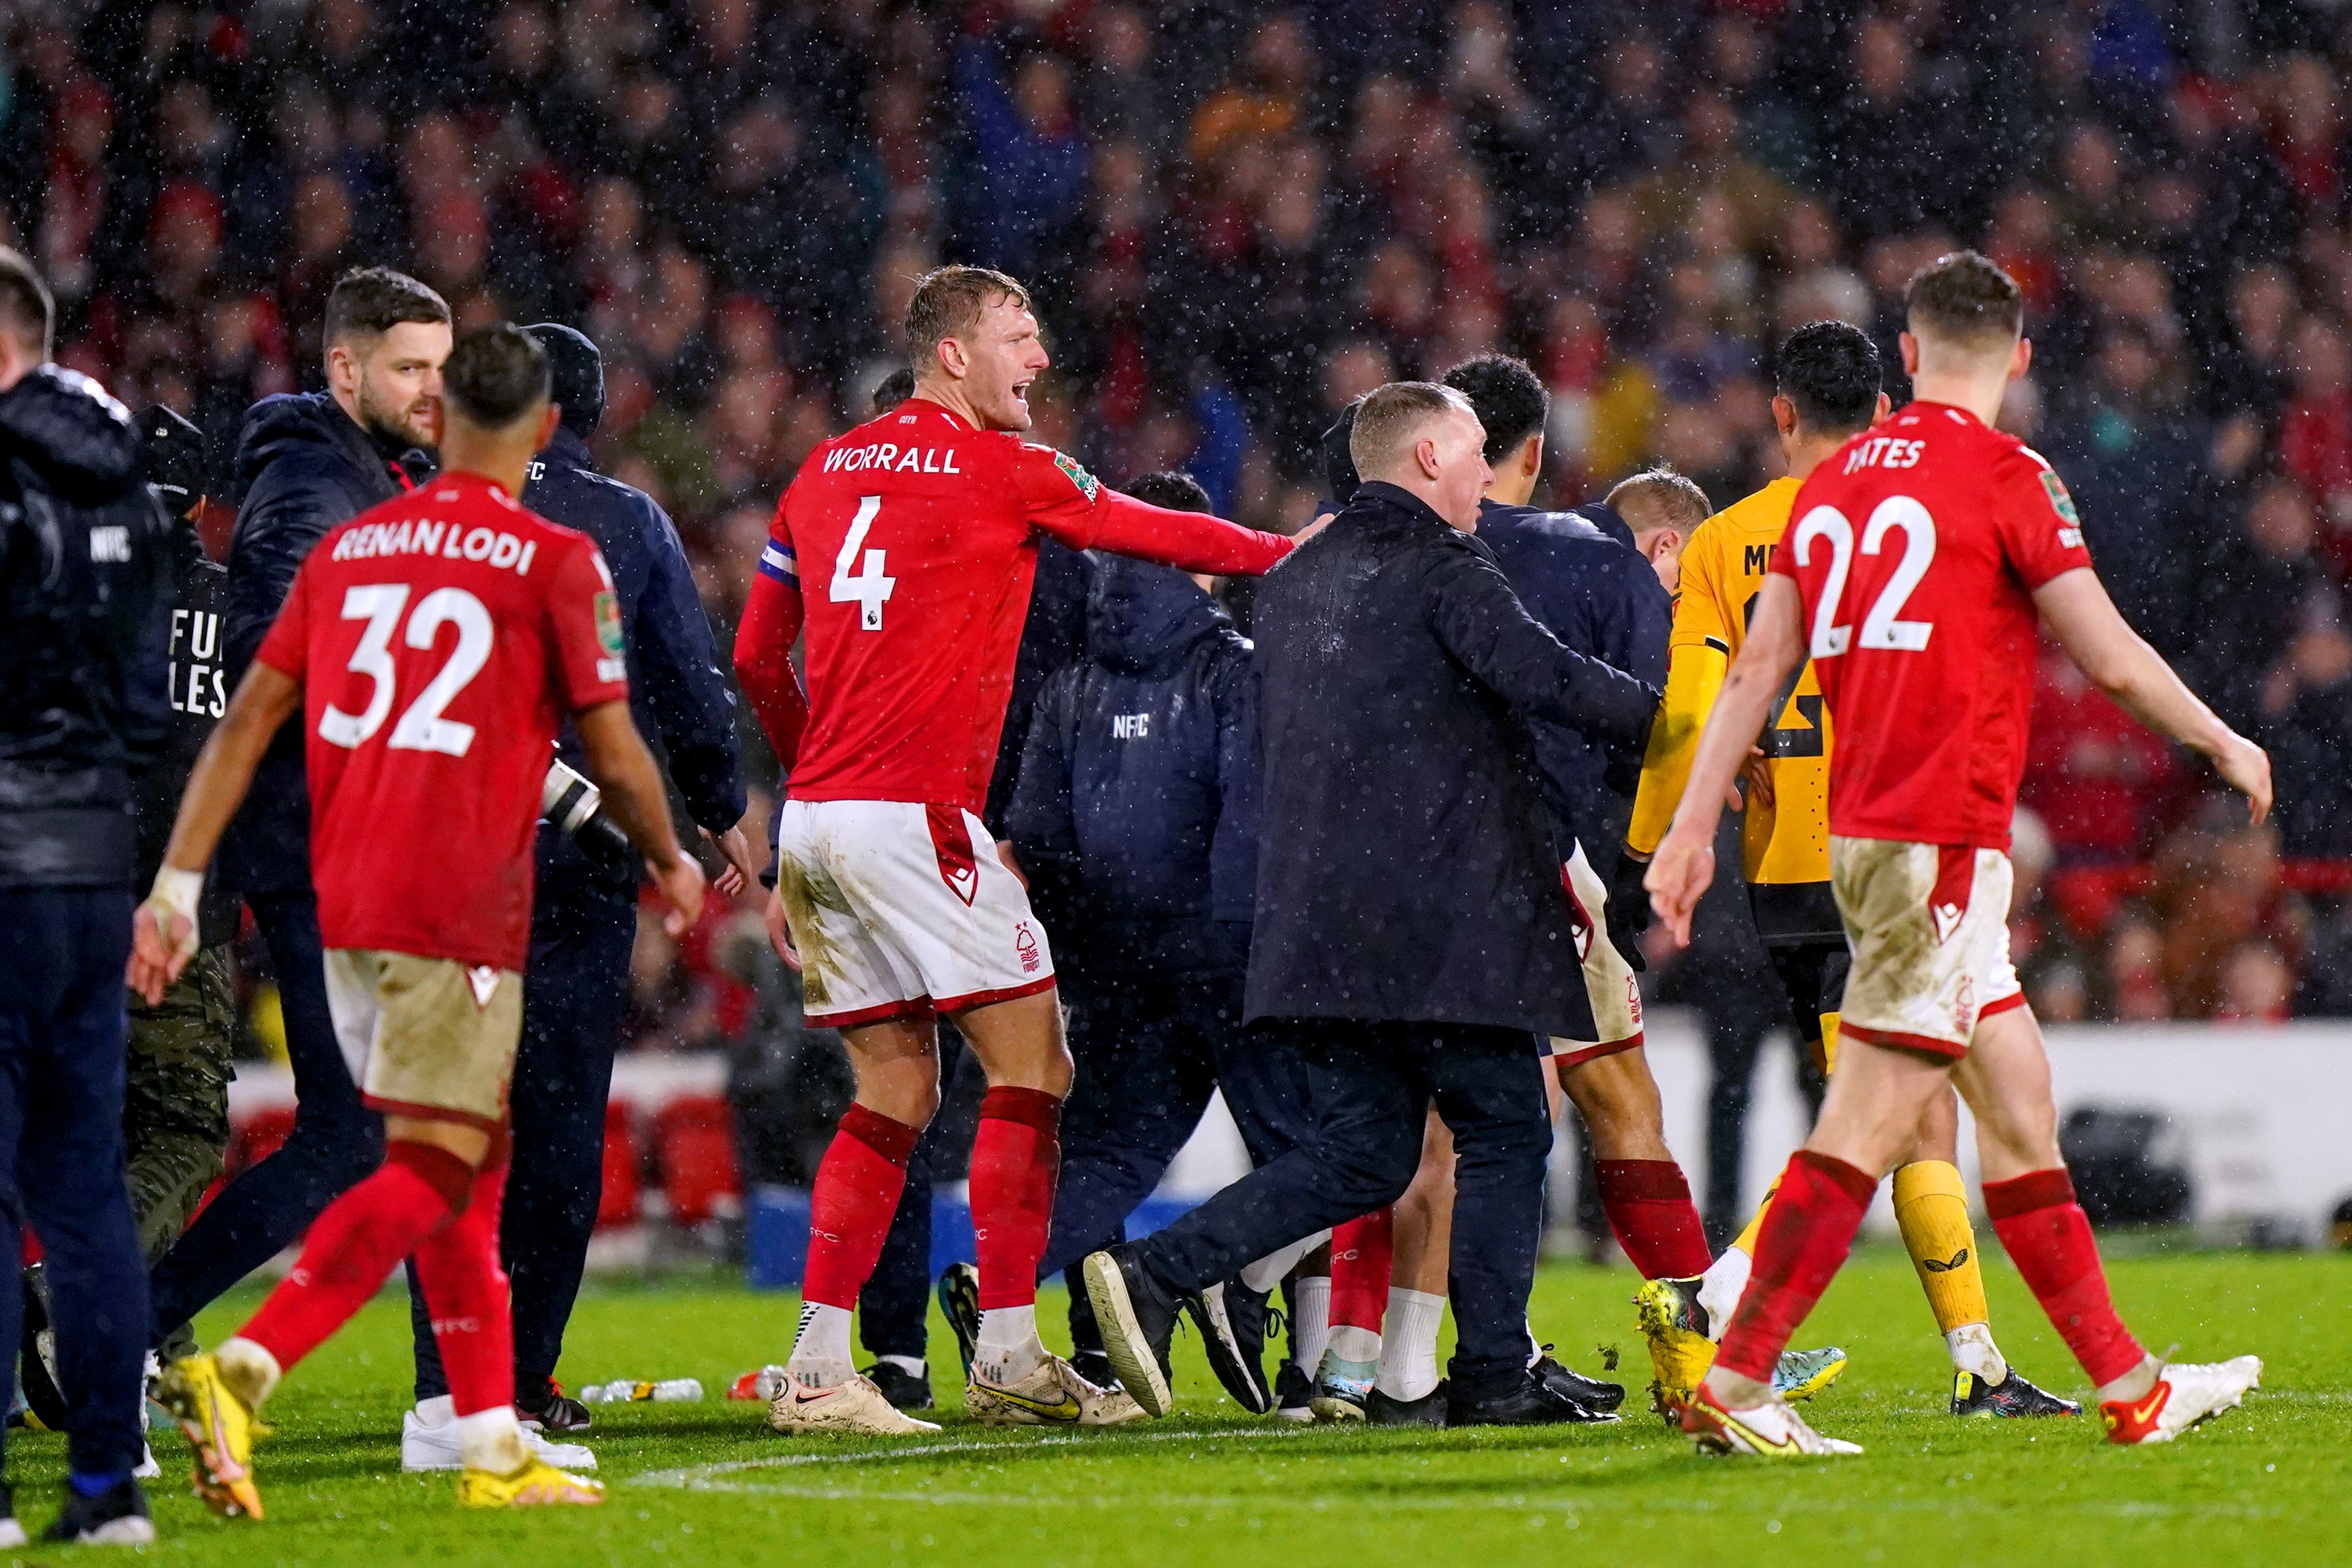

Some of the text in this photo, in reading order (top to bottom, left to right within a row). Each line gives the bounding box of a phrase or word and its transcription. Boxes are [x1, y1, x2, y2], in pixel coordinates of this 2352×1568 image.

[824, 443, 960, 474] WORRALL
[332, 520, 536, 576] RENAN LODI
[829, 495, 896, 631] 4
[1793, 495, 1936, 659] 22
[169, 609, 226, 662] FU
[317, 584, 493, 757] 32
